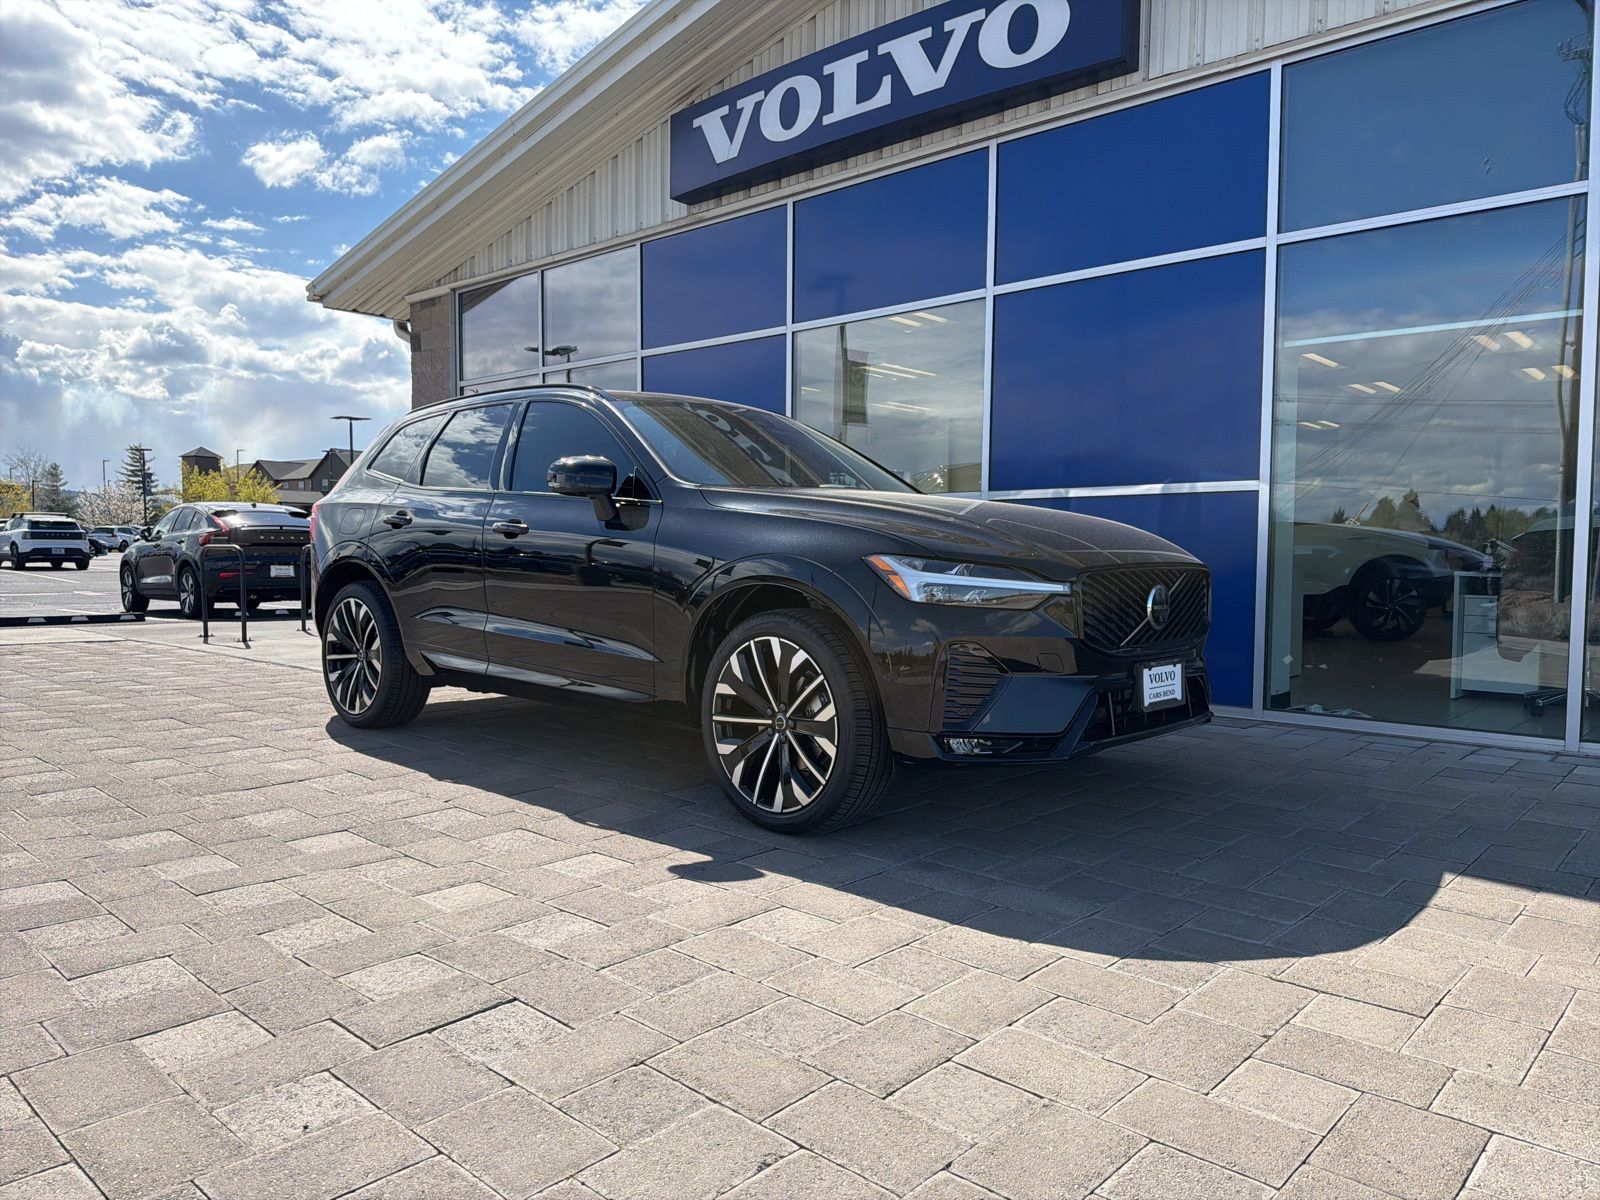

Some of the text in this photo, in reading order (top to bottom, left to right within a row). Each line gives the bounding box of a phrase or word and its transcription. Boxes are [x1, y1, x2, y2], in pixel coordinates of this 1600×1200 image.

[692, 0, 1071, 165] VOLVO
[1148, 670, 1176, 684] VOLVO
[1148, 689, 1176, 700] CARS BEND
